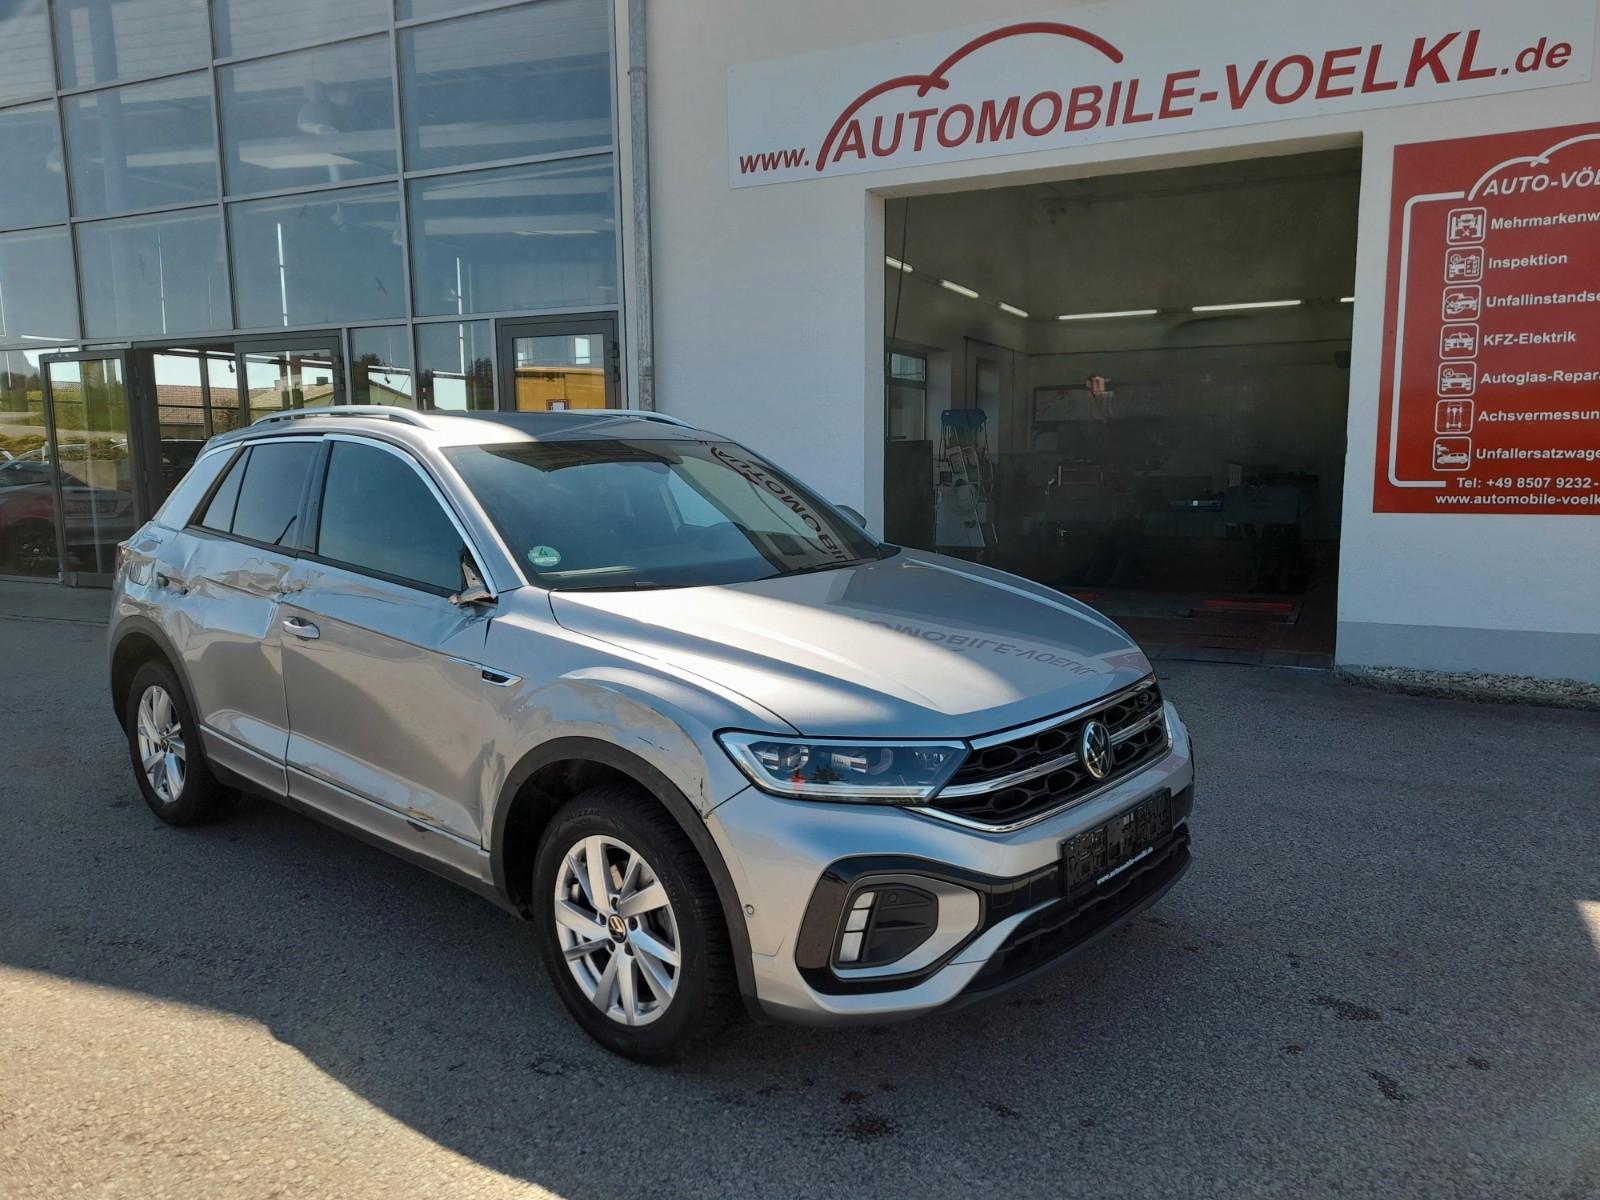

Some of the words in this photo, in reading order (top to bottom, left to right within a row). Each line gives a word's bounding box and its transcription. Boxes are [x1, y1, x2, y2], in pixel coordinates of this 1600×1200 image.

[1491, 211, 1600, 231] Mehrmarkenw
[1488, 253, 1568, 270] Inspektion
[1483, 331, 1577, 346] KFZ-Elektrik
[1480, 369, 1600, 386] Autoglas-Repar
[1478, 410, 1600, 422] Achsvermessun
[1456, 477, 1482, 489] Tel:
[1486, 477, 1512, 489] +49
[1516, 477, 1551, 489] 8507
[1435, 493, 1600, 506] www.automobile-voelk
